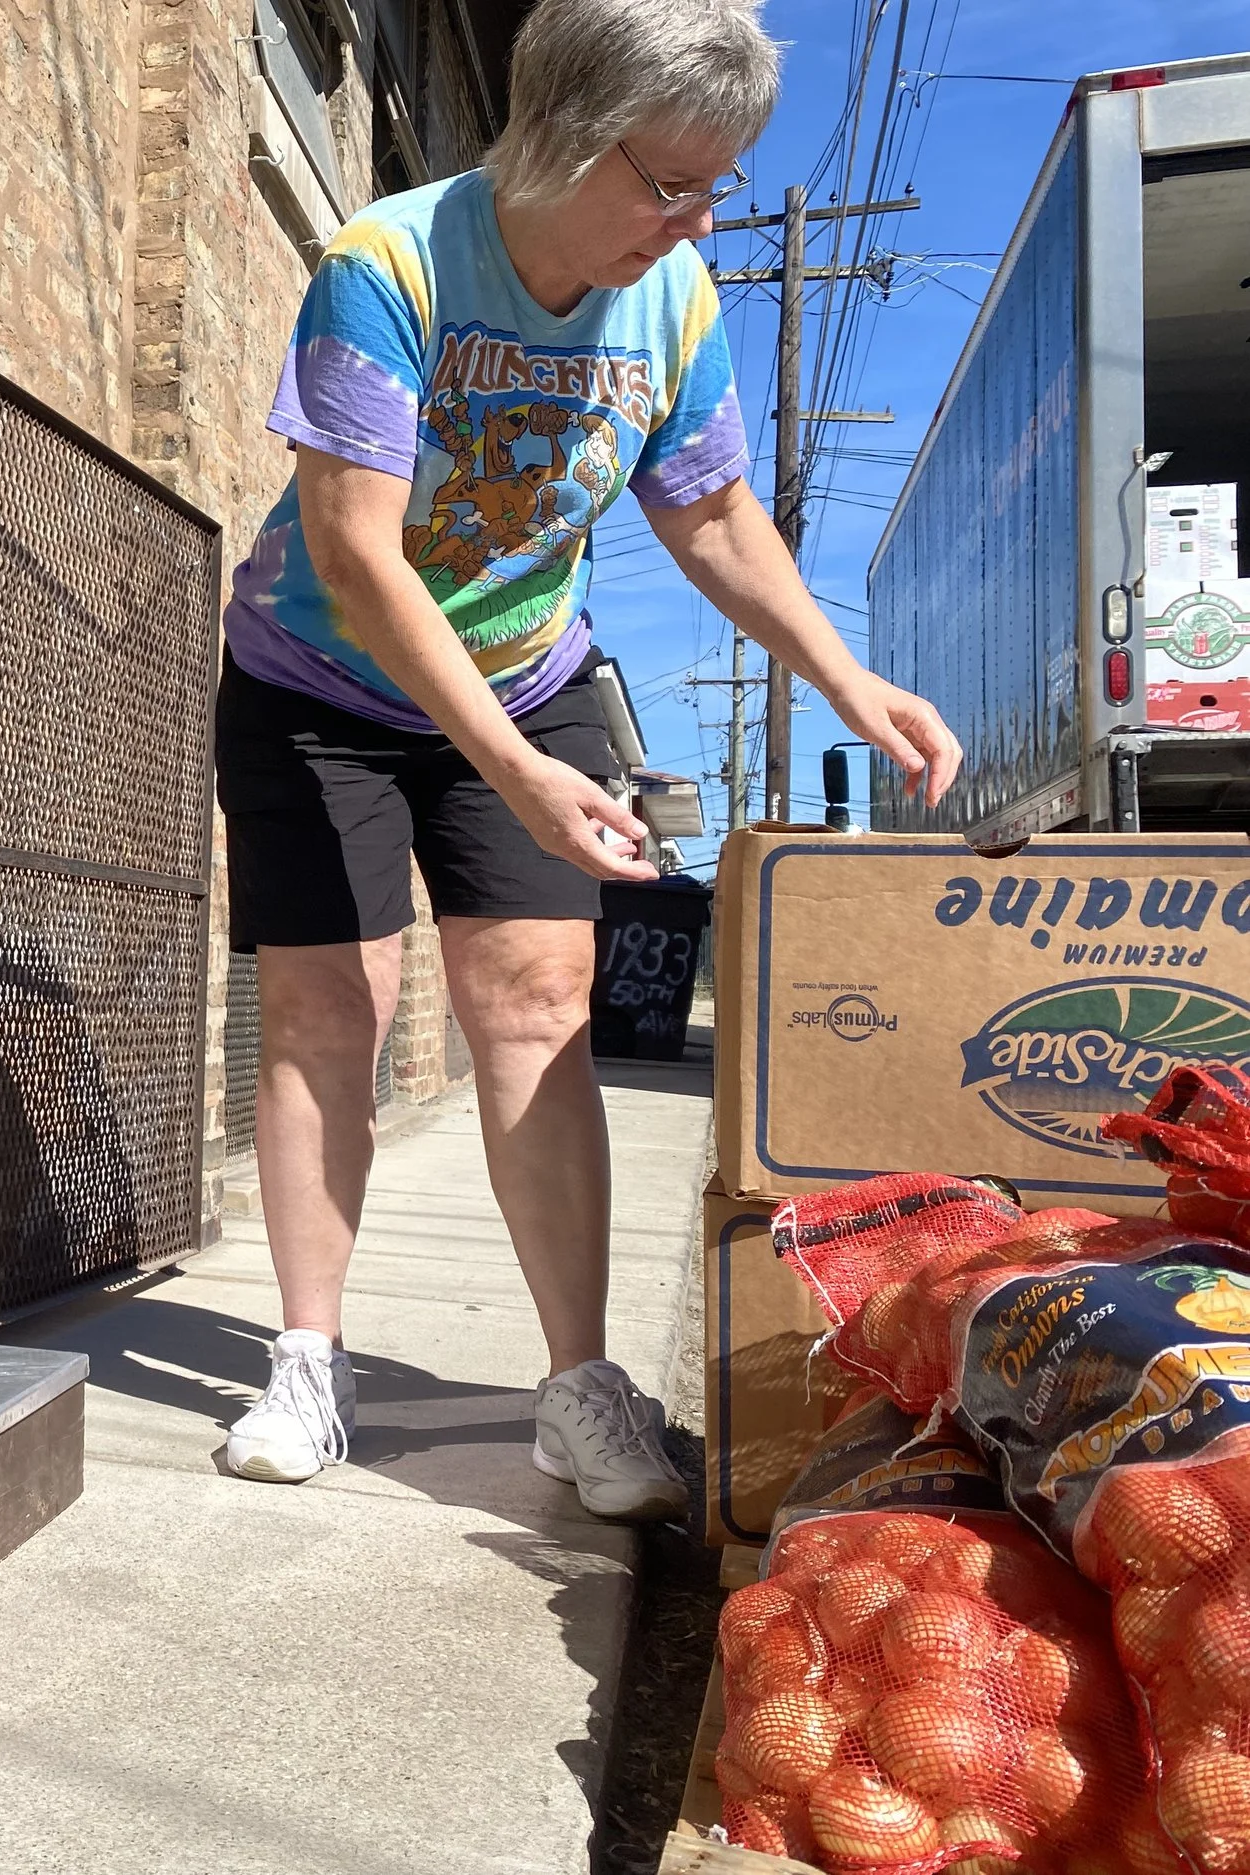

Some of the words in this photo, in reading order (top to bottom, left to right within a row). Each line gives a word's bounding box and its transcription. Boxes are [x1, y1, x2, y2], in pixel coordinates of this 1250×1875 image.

[1145, 629, 1166, 637] uality
[935, 876, 1250, 950] omaine
[603, 921, 692, 986] 1933
[1063, 943, 1208, 968] PREMIUM
[841, 983, 857, 992] food
[987, 1029, 1250, 1090] chSide
[1001, 1287, 1086, 1389] Onions
[1048, 1331, 1078, 1365] The
[1075, 1302, 1117, 1337] Best
